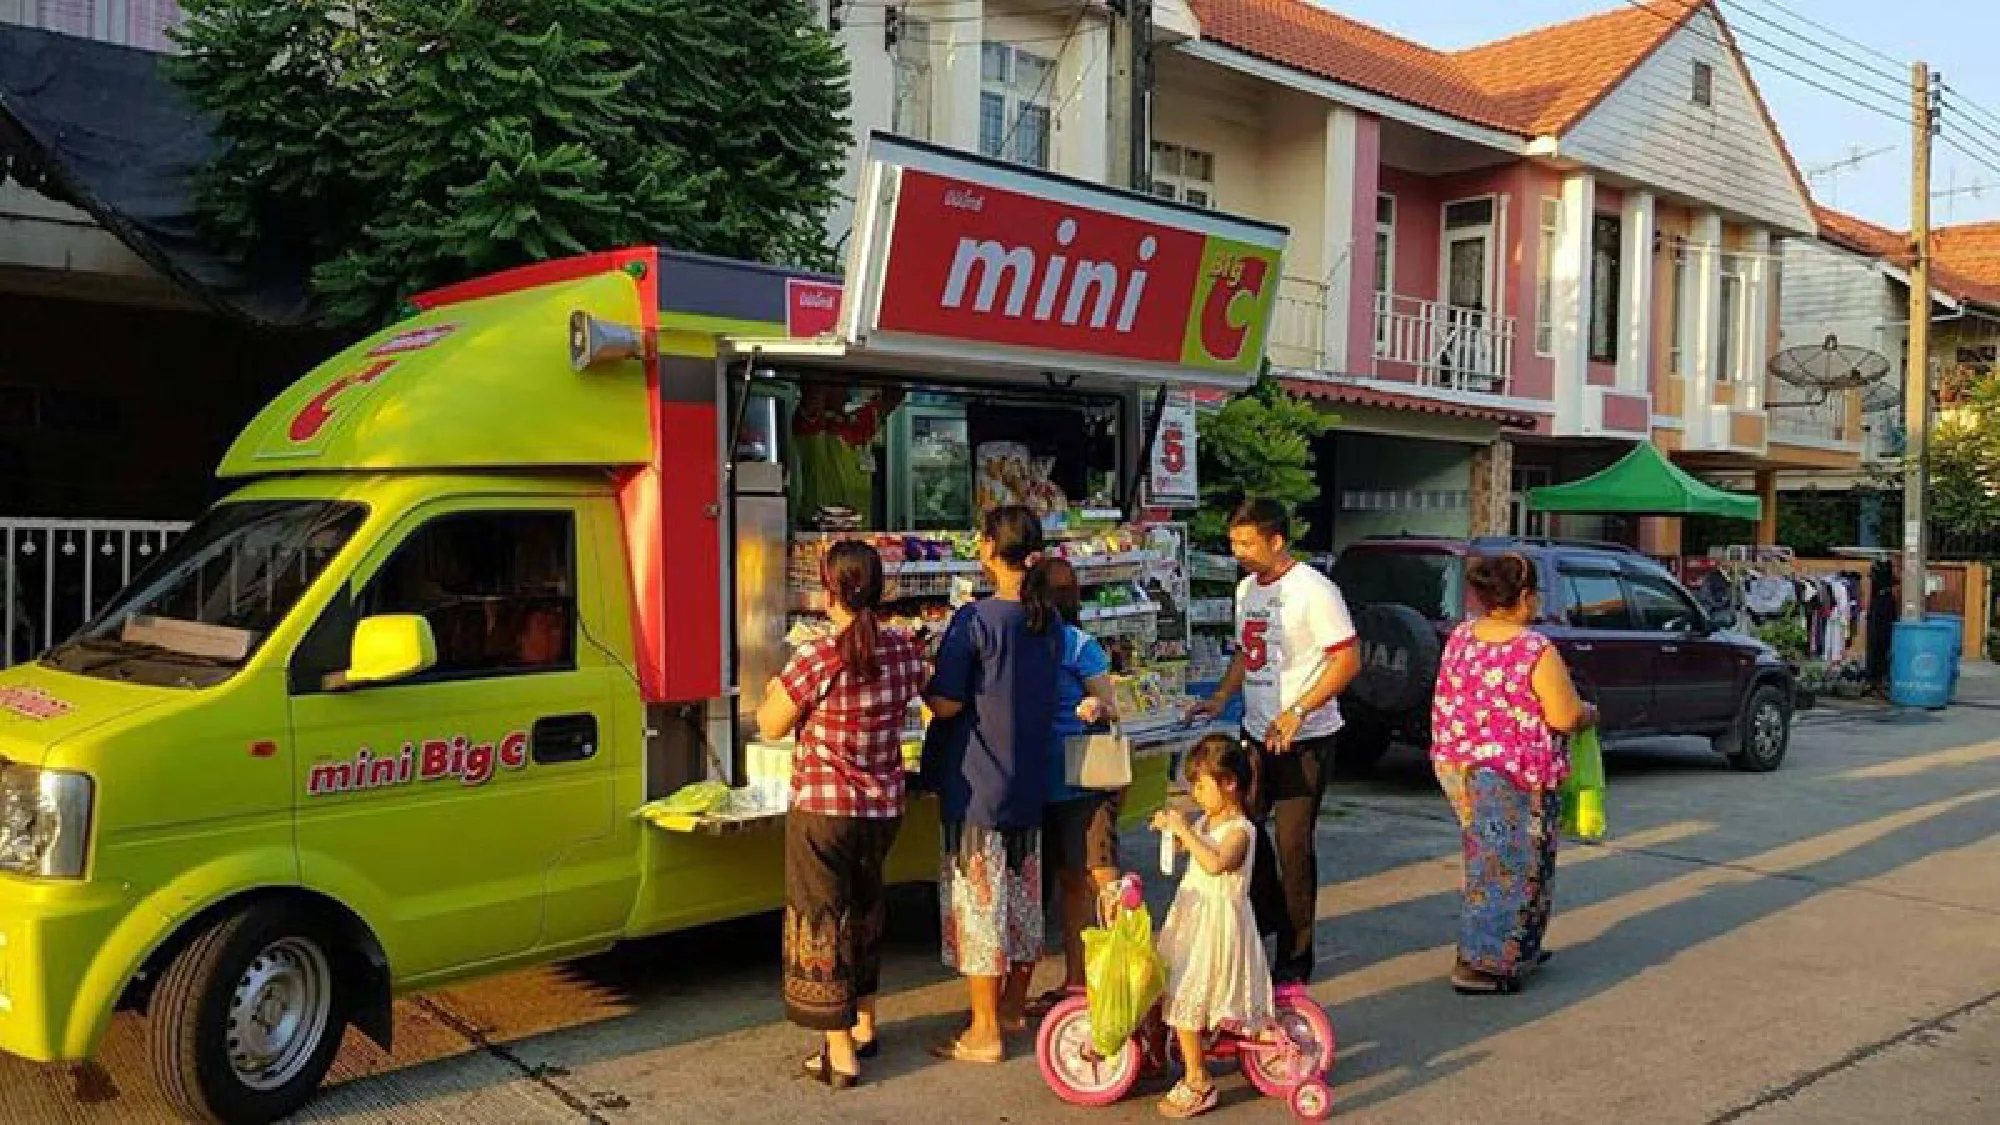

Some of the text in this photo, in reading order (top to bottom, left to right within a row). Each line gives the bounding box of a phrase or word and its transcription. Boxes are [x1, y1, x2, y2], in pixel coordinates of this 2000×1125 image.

[941, 217, 1157, 332] mini
[1200, 255, 1268, 361] C
[1161, 429, 1186, 474] 5
[1241, 620, 1268, 673] 5
[307, 730, 530, 795] mini Big C
